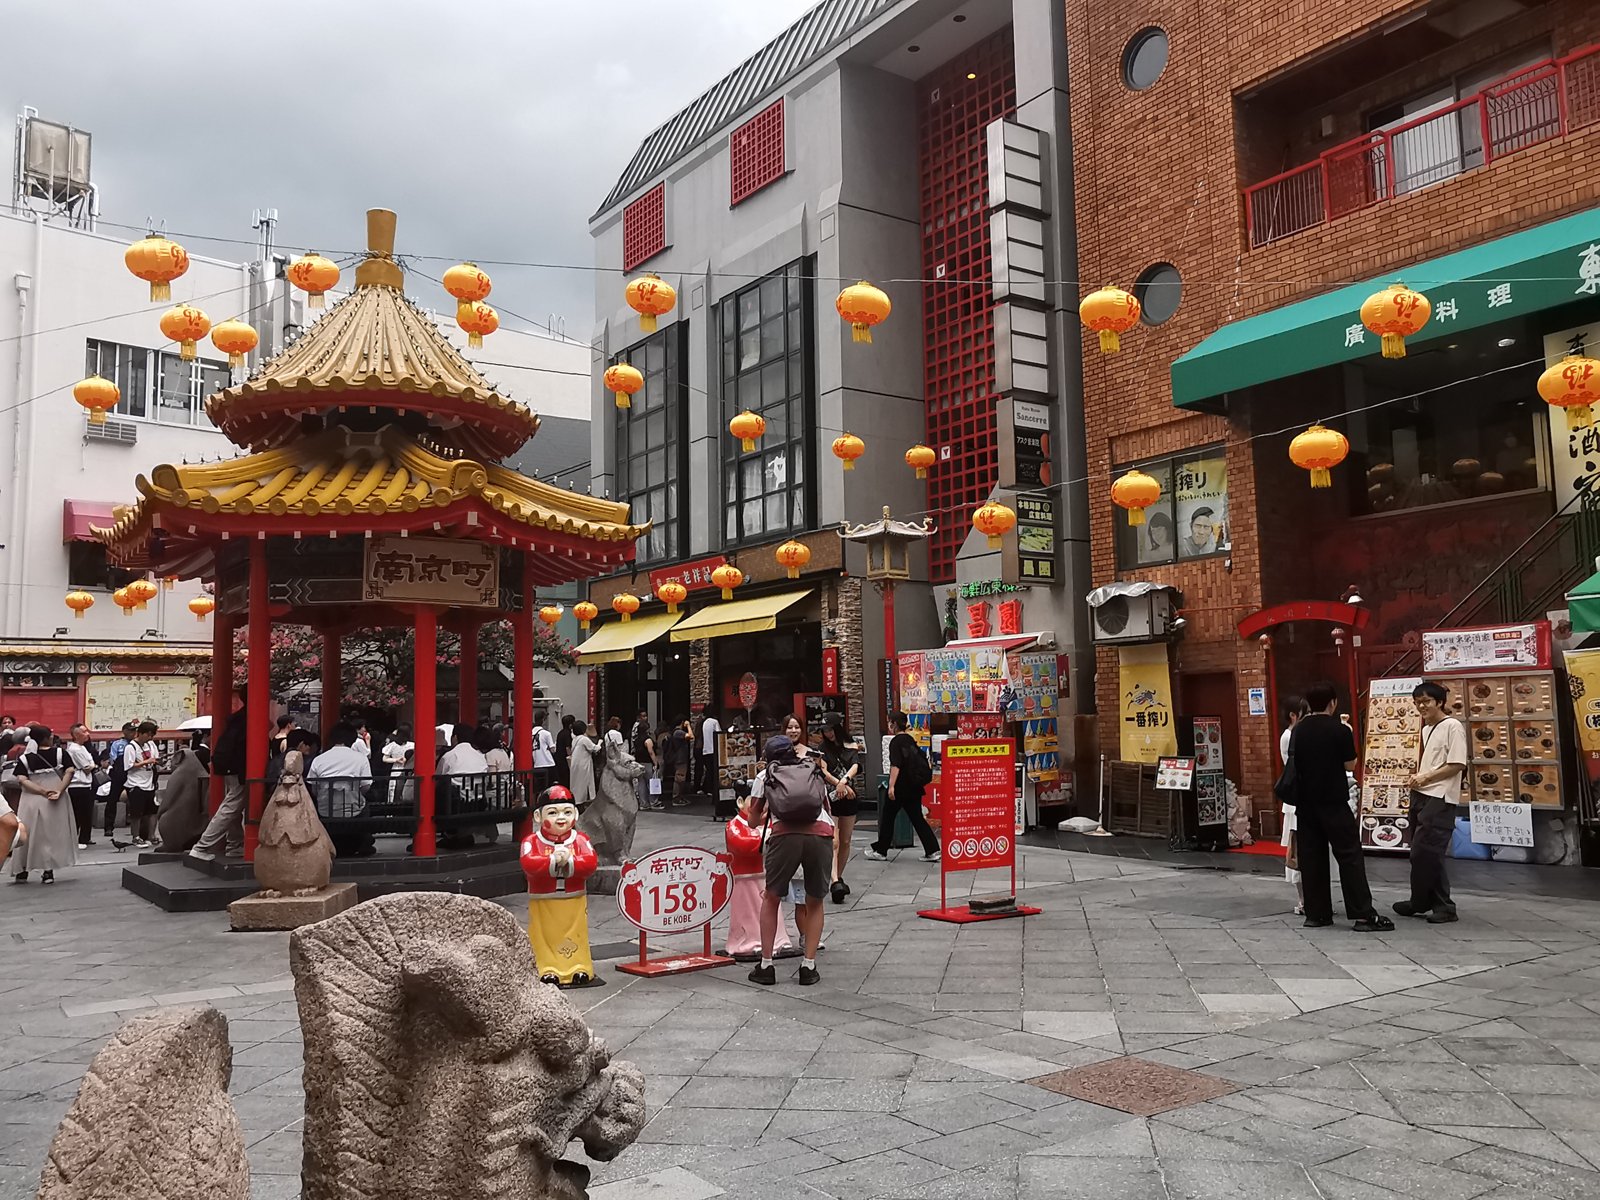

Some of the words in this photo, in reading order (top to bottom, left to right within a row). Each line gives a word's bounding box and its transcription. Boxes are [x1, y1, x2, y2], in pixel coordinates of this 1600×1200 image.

[1344, 282, 1513, 348] 廣料理
[1016, 412, 1047, 425] Sancerre
[373, 551, 492, 587] 南京町
[1125, 711, 1168, 728] 一番搾り
[651, 856, 703, 875] 南京町
[663, 917, 672, 926] BE
[674, 914, 692, 924] KOBE
